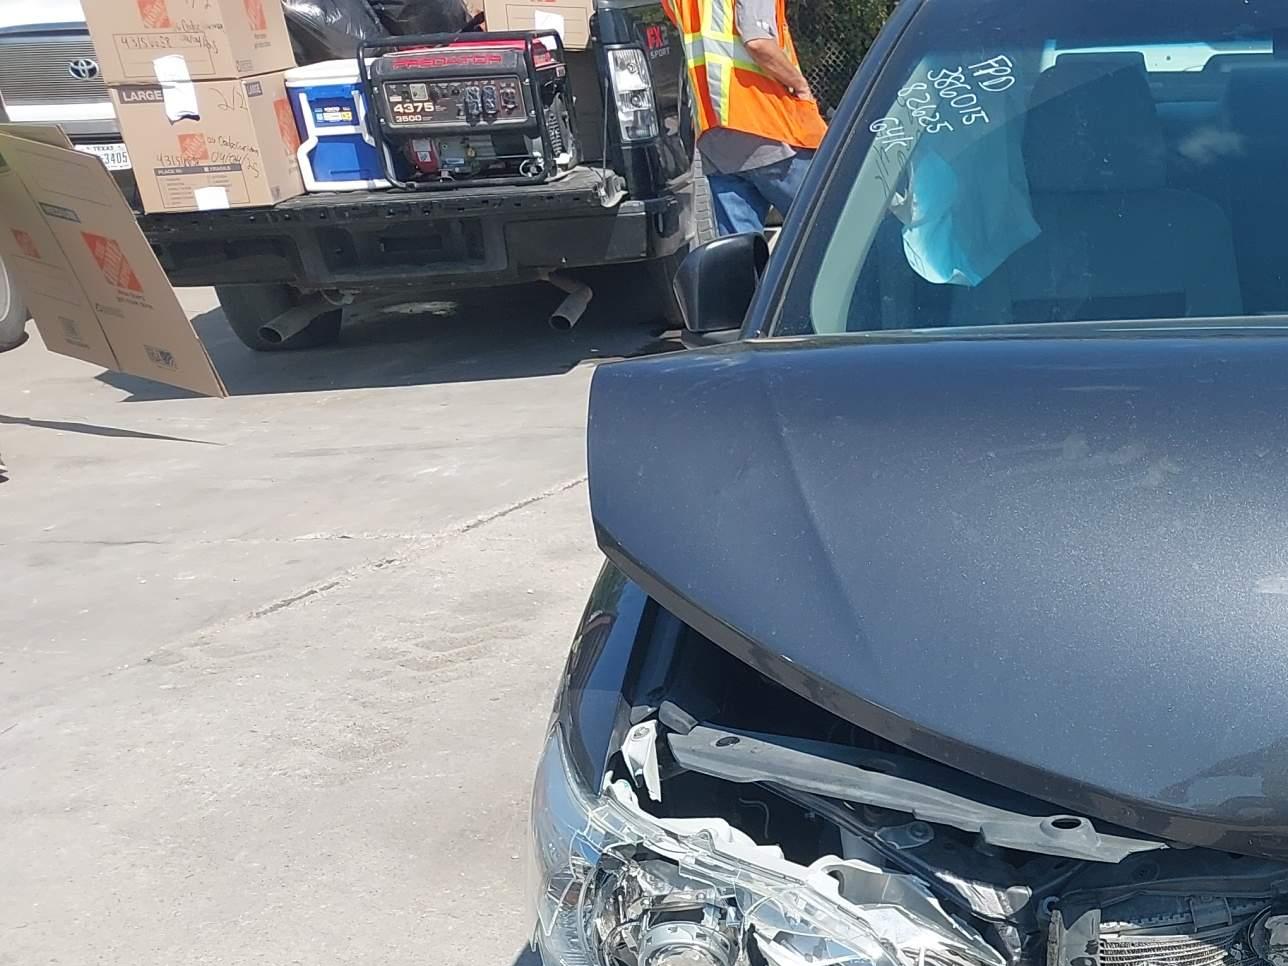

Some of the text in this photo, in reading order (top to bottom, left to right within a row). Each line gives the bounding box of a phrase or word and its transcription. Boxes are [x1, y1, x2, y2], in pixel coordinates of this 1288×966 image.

[650, 46, 670, 59] SPORT
[393, 54, 502, 70] PREDATOR
[968, 55, 1016, 92] FPD
[122, 90, 163, 102] LARGE
[393, 102, 434, 113] 4375
[897, 83, 954, 134] 82625
[396, 115, 422, 123] 3500
